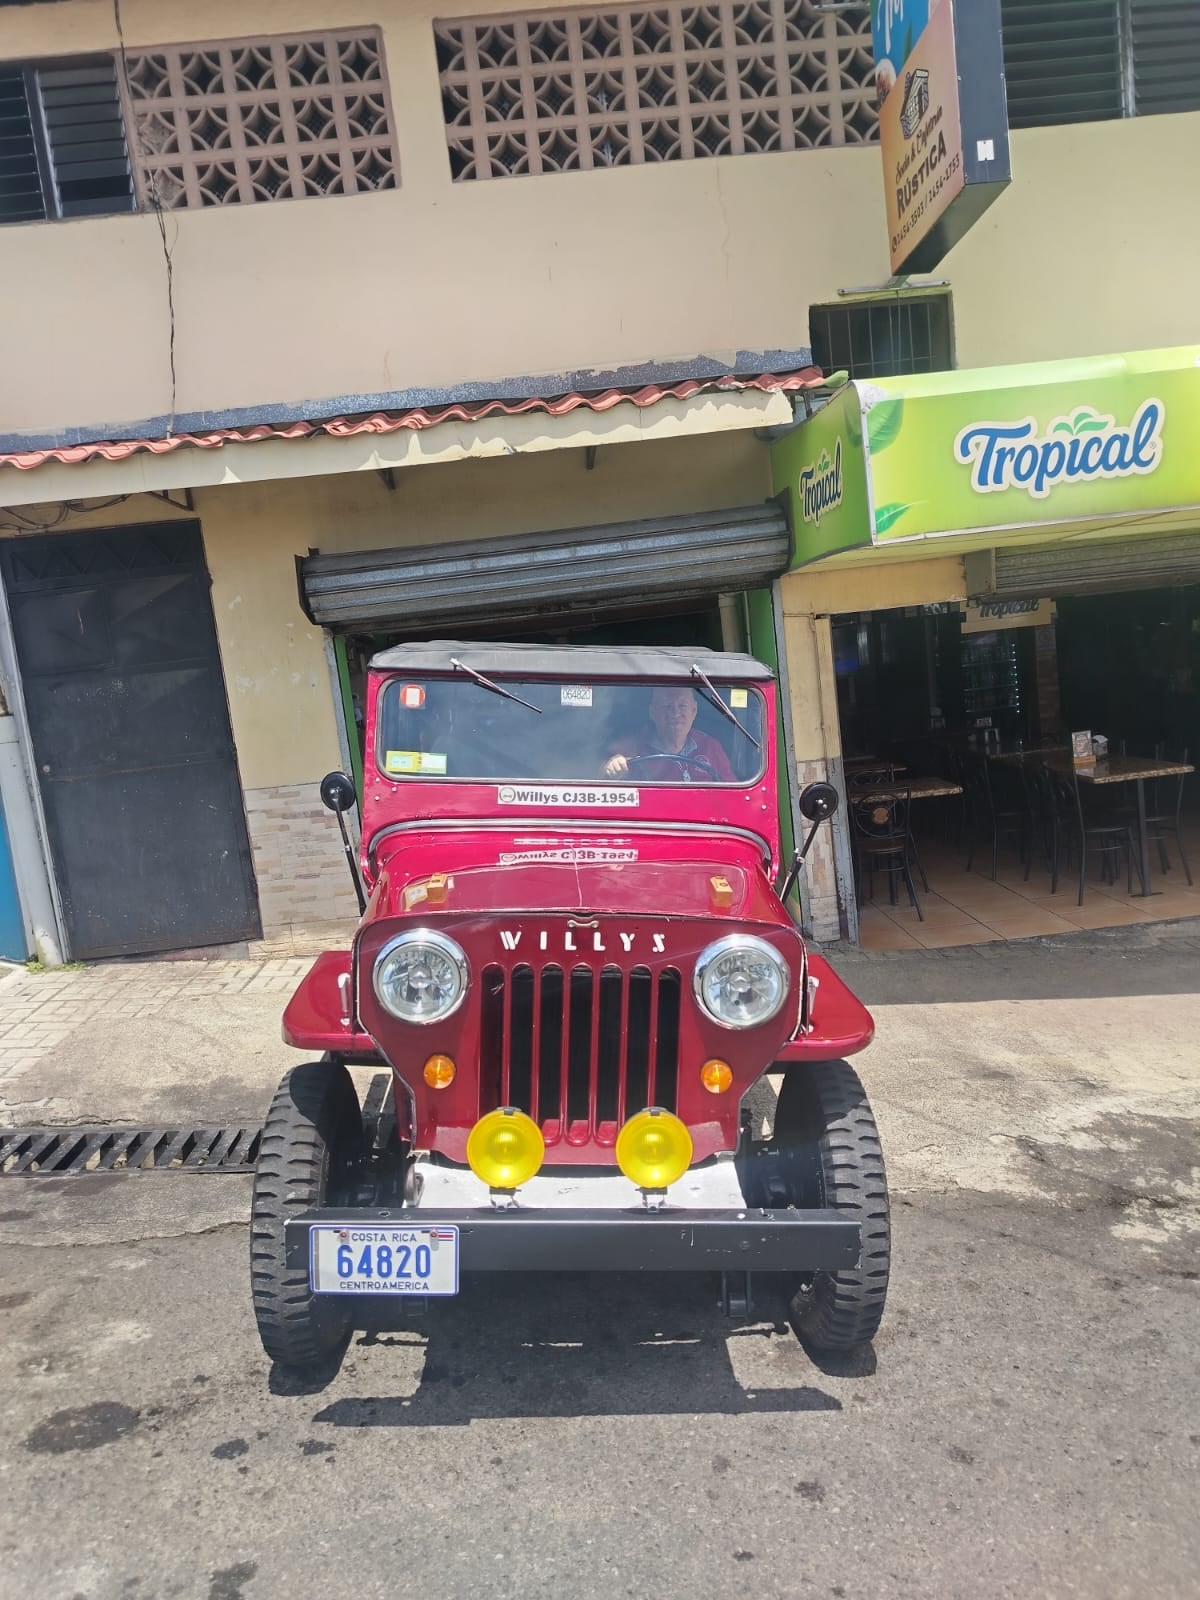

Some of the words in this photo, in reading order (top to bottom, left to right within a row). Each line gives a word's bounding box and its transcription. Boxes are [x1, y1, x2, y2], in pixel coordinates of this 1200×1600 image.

[896, 129, 947, 219] RÚSTICA
[960, 404, 1159, 492] Tropical
[800, 441, 842, 522] Tropical
[516, 791, 559, 804] Willys
[562, 792, 635, 804] CJ3B-1954
[500, 931, 665, 953] WILLYS
[351, 1232, 387, 1242] COSTA
[392, 1232, 417, 1242] RICA
[337, 1244, 431, 1278] 64820
[339, 1281, 429, 1290] CENTROAMERICA
